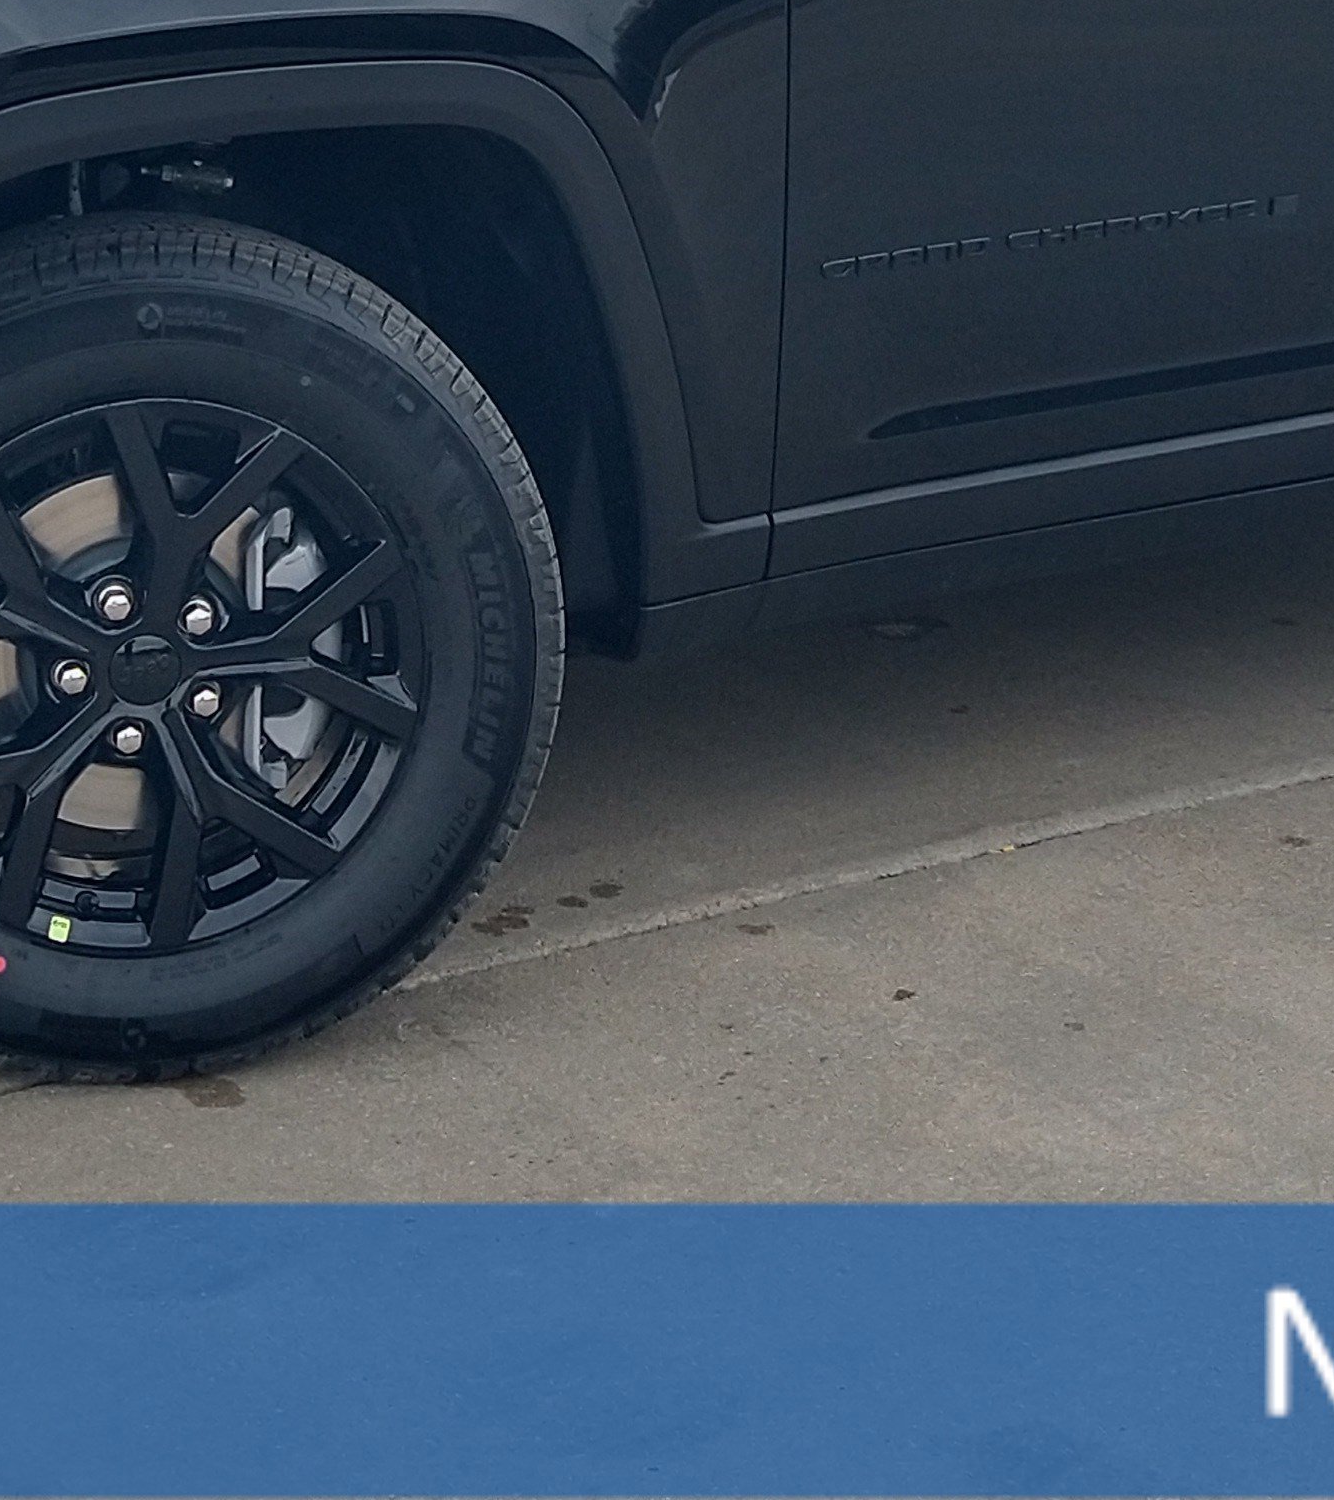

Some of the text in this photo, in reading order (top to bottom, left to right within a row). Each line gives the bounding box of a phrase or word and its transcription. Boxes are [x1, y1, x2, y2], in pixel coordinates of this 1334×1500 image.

[820, 199, 1257, 279] GRAND CHEROKEE
[469, 550, 512, 763] MICHELIN
